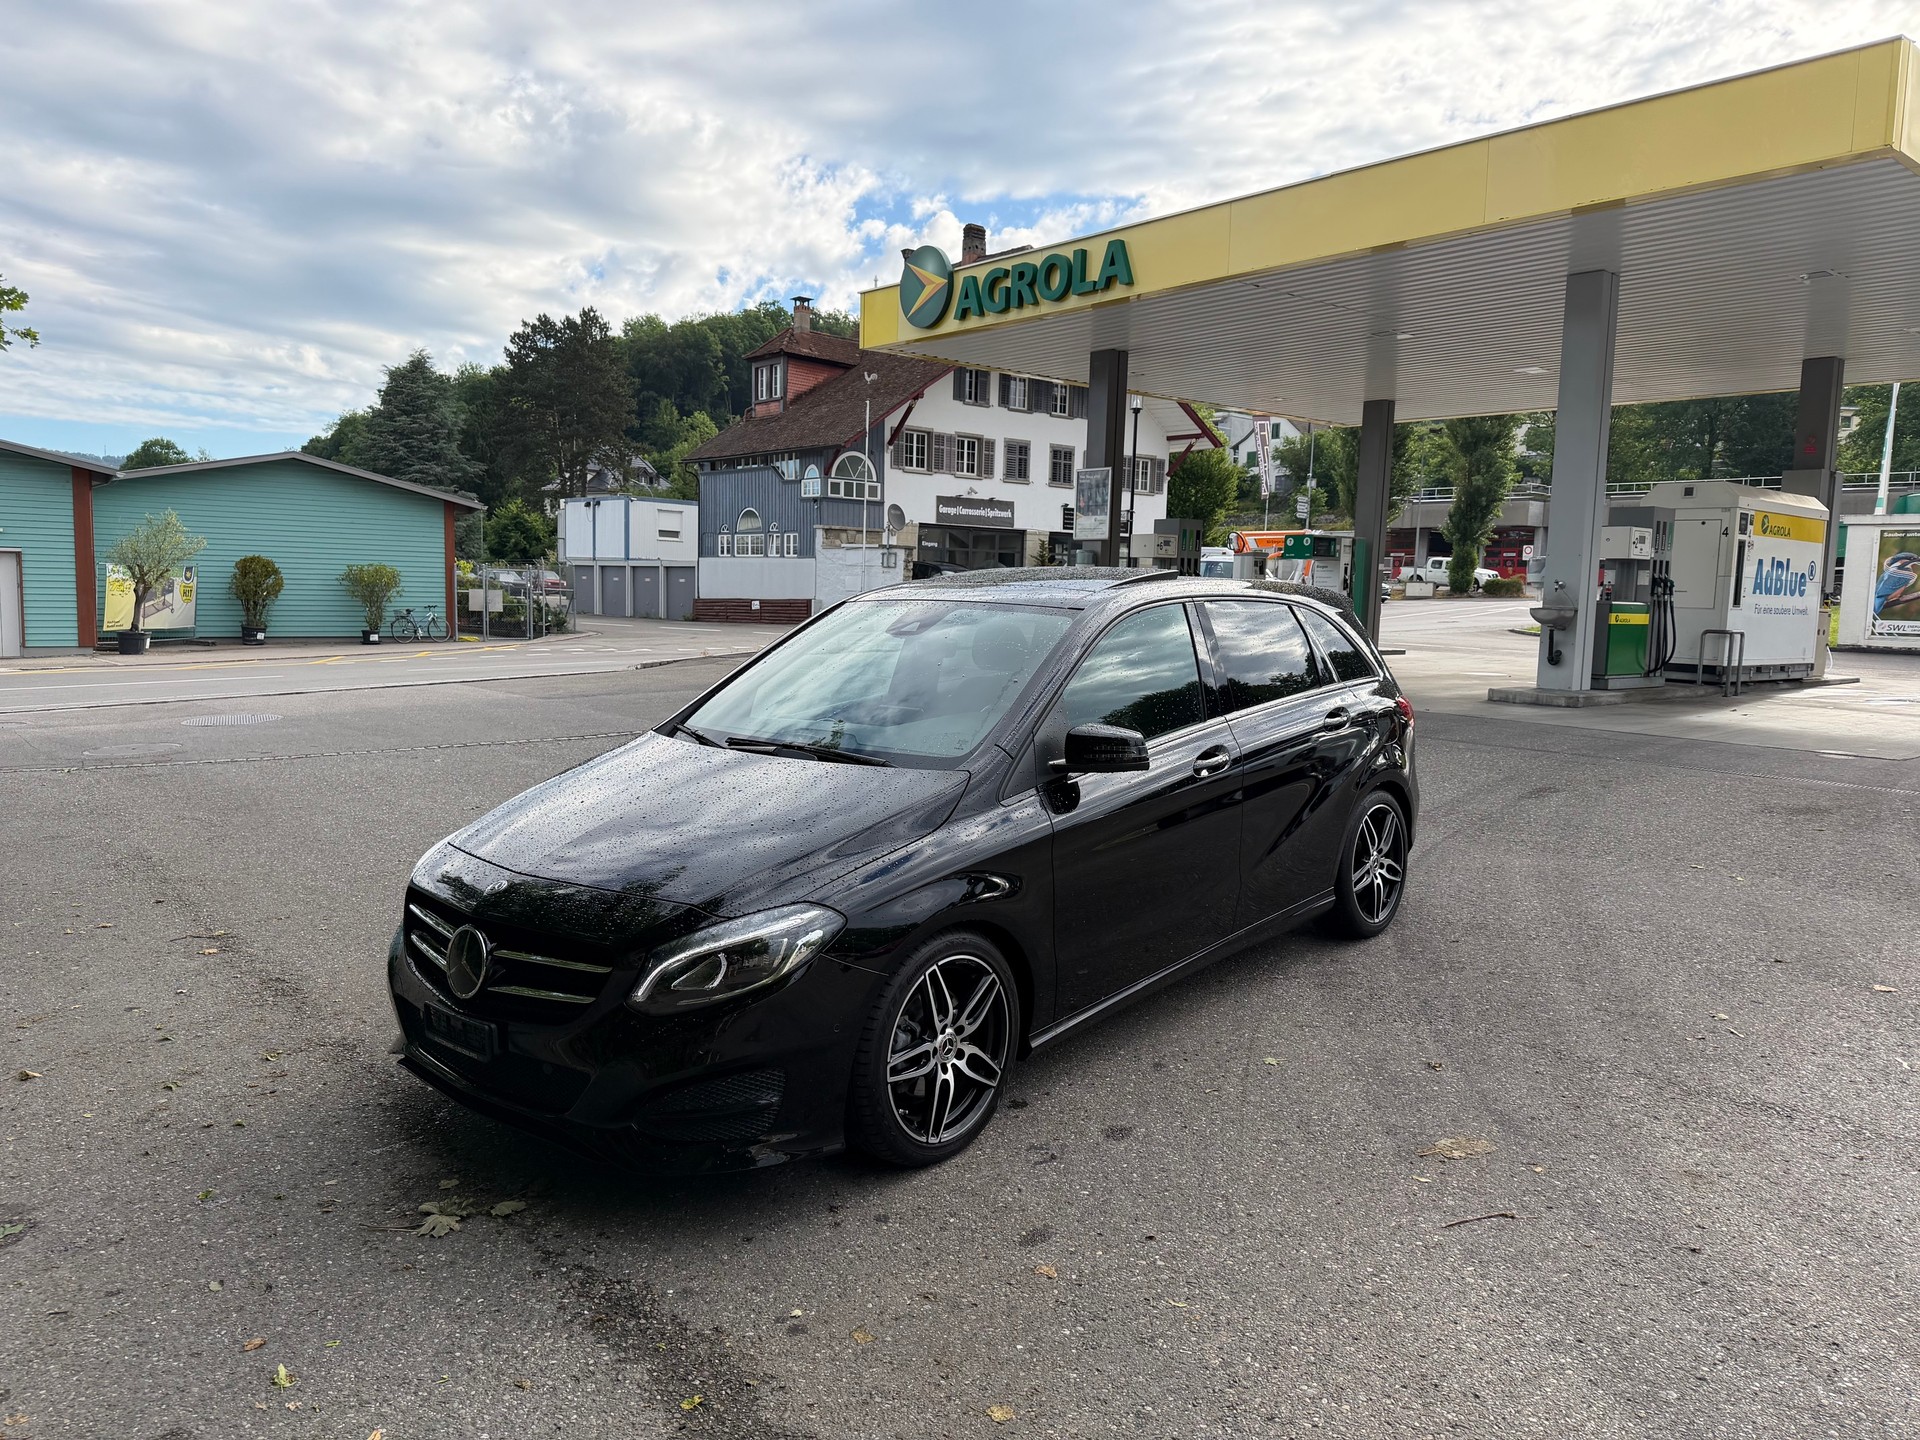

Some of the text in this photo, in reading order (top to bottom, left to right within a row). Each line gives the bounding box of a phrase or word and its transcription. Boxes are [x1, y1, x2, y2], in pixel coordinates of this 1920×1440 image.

[953, 238, 1134, 321] AGROLA
[938, 504, 957, 516] Garage
[1722, 527, 1729, 537] 4
[1769, 525, 1791, 537] AGROLA
[921, 540, 938, 548] Eingang
[1159, 541, 1164, 551] 6
[1763, 604, 1773, 615] eine
[1886, 624, 1906, 632] SWL
